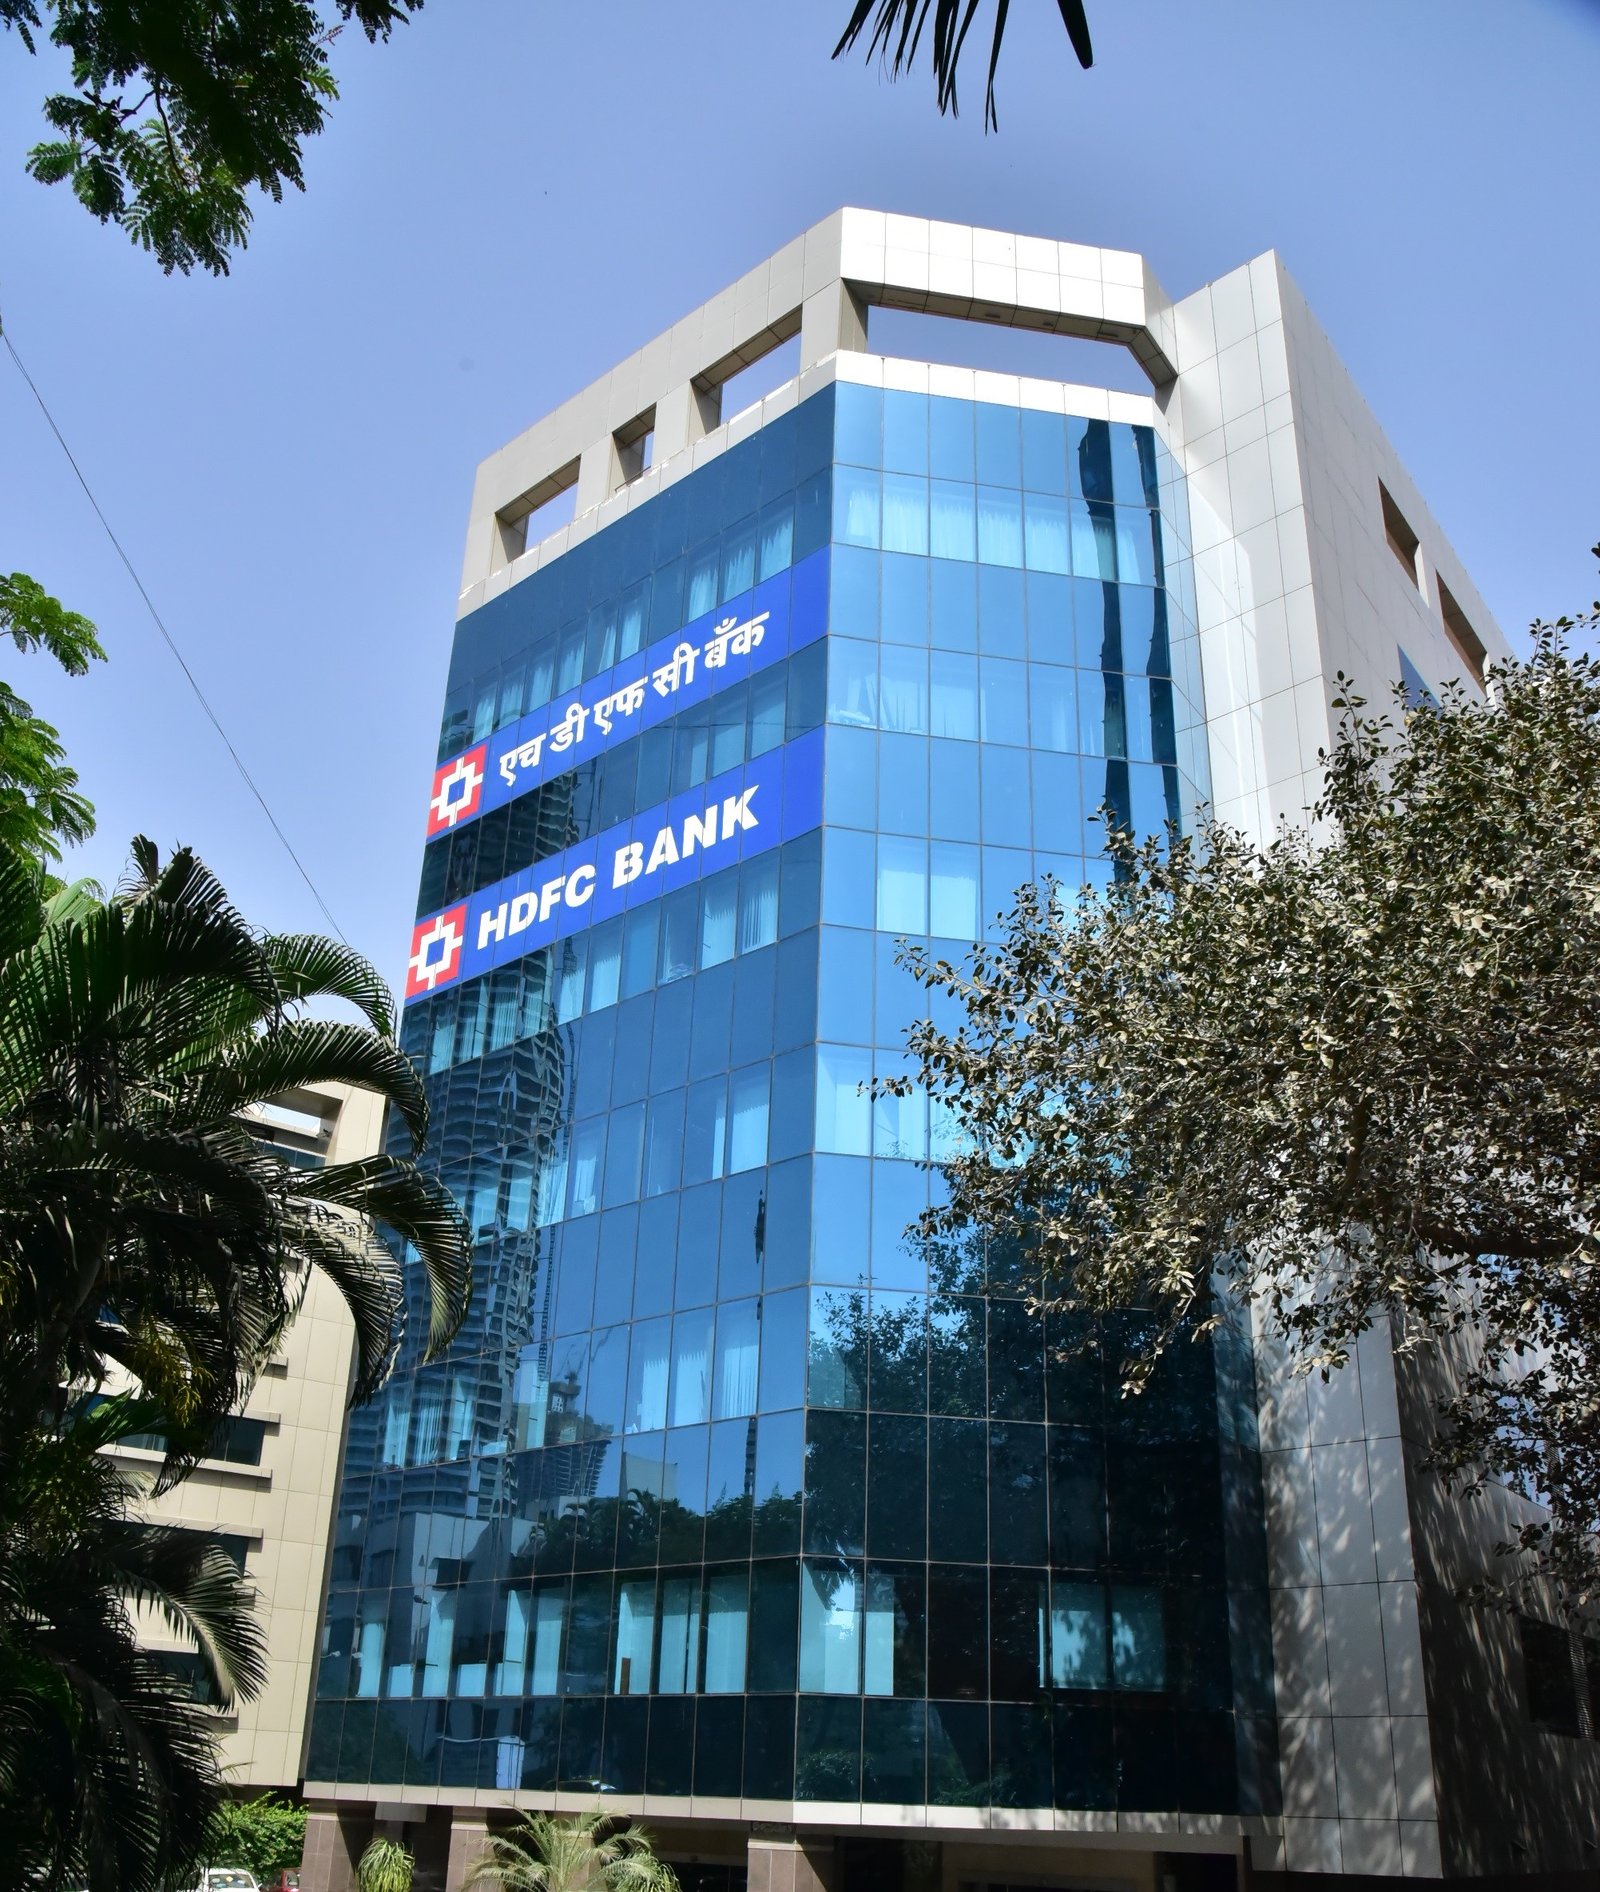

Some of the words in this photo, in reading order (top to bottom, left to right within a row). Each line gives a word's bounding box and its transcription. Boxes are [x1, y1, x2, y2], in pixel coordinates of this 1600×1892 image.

[499, 732, 547, 787] एच
[550, 702, 590, 752] डी
[593, 676, 649, 736] एफ
[652, 642, 701, 697] सी
[477, 864, 596, 949] HDFC
[612, 785, 759, 889] BANK
